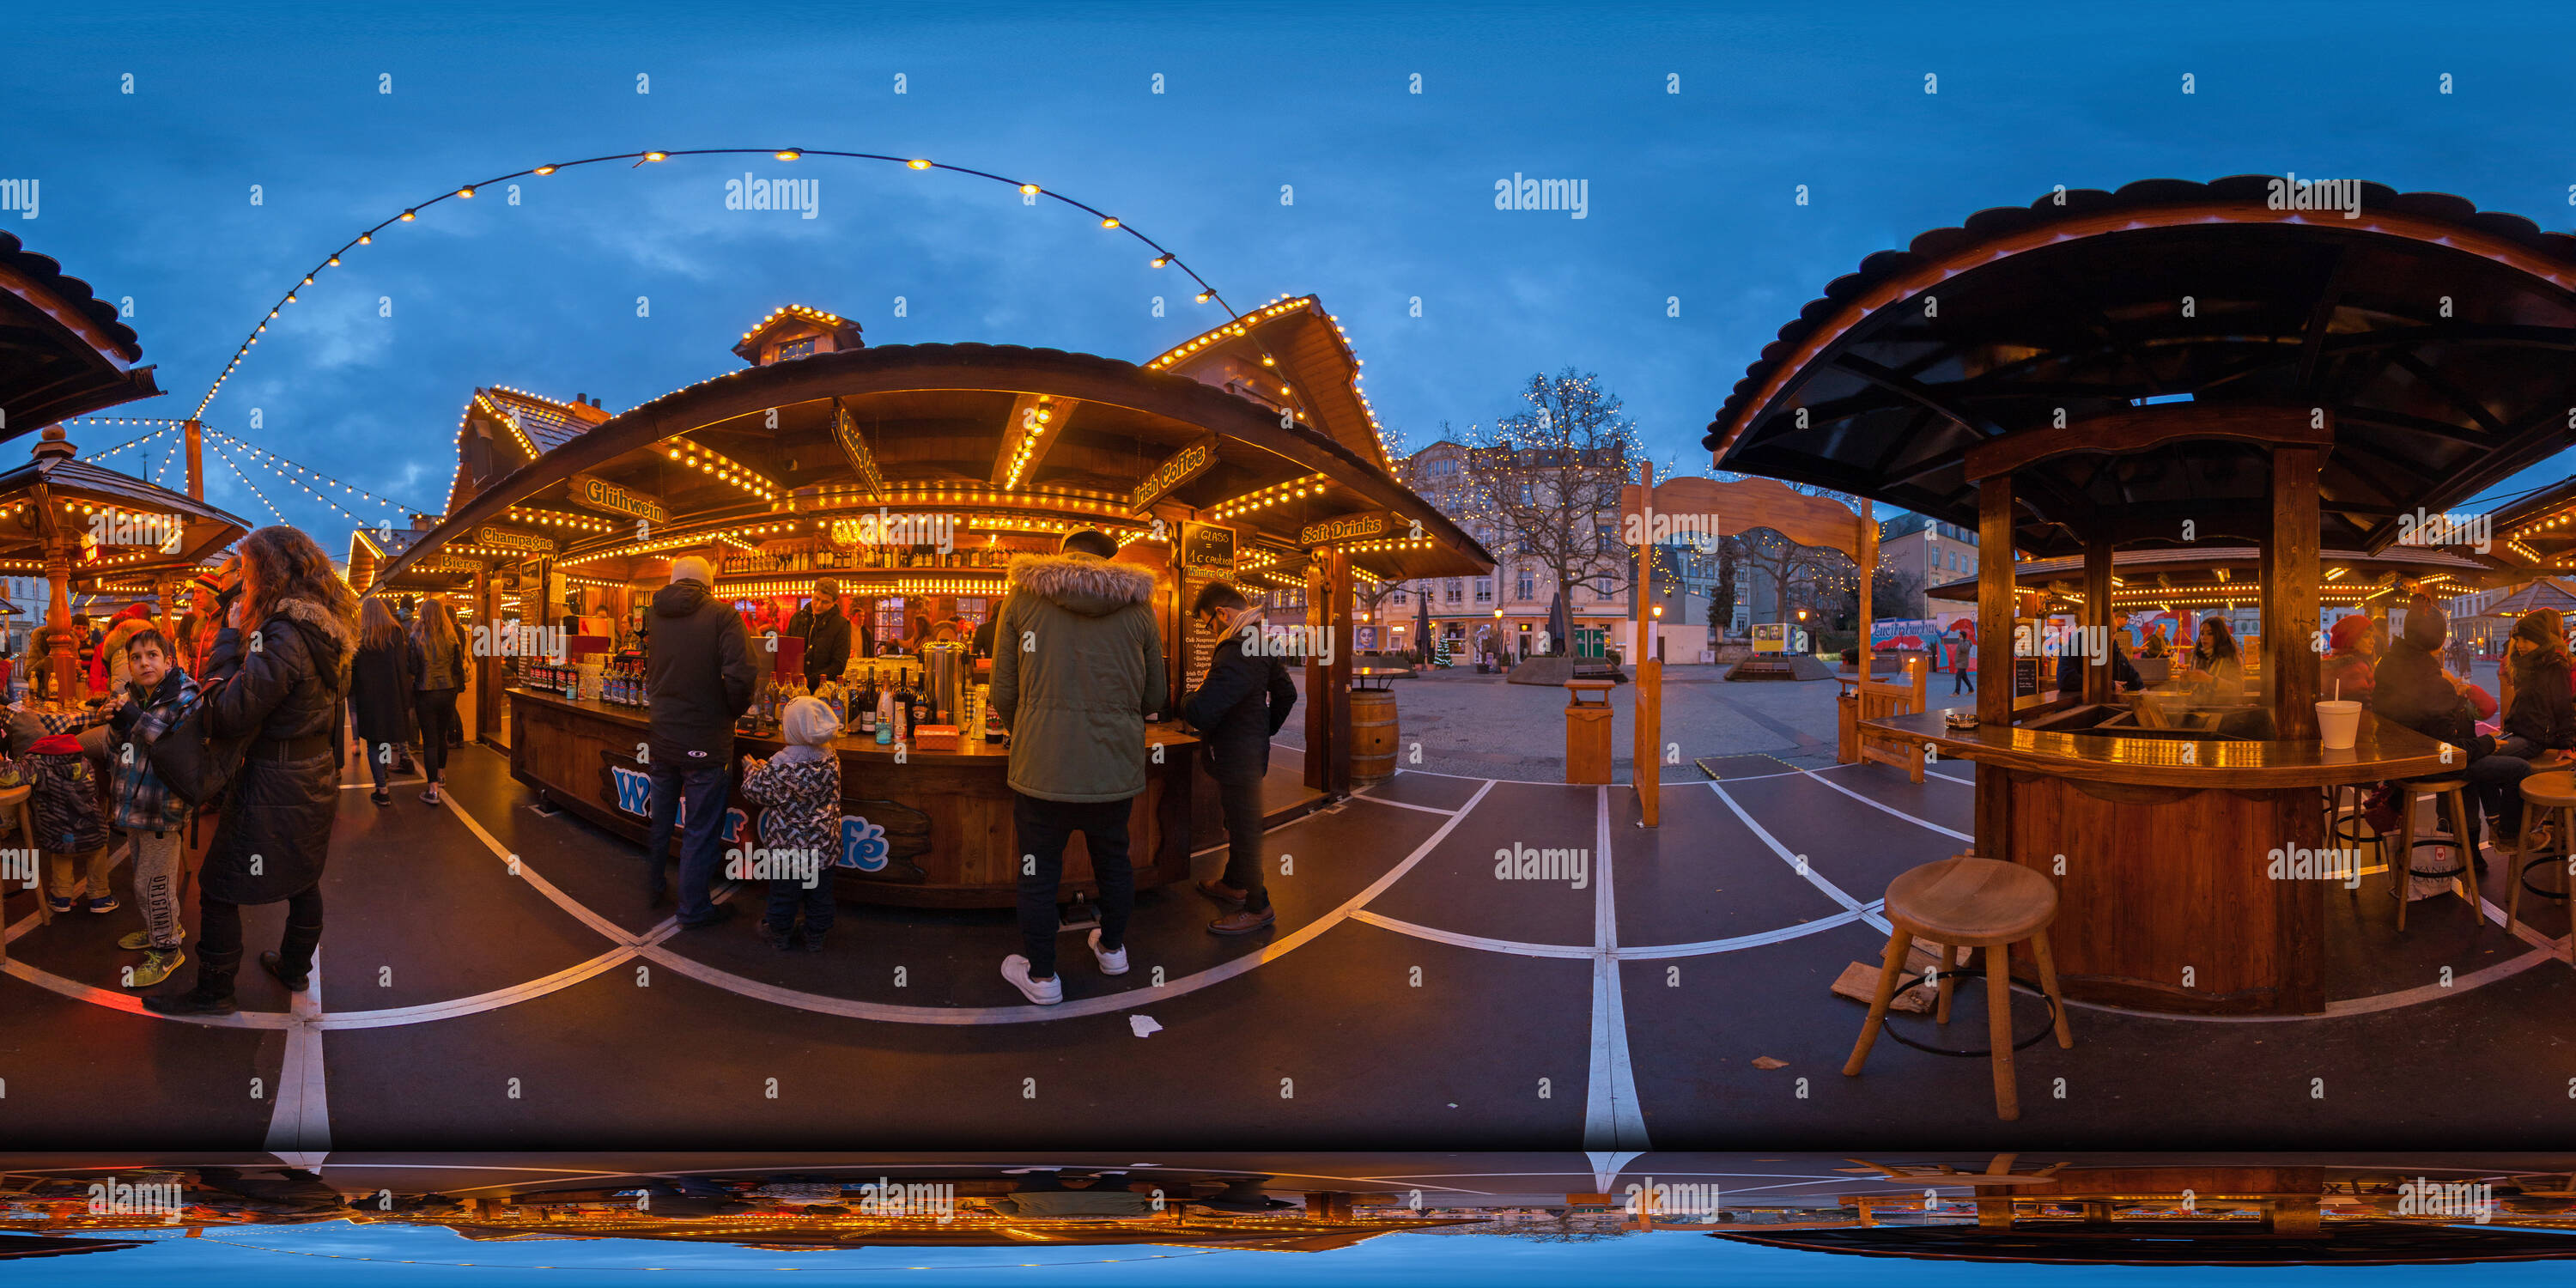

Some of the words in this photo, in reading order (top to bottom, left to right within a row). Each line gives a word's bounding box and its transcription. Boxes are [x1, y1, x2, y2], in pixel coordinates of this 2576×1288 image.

[1133, 474, 1158, 508] Irish
[1161, 446, 1206, 489] Coffee
[585, 479, 664, 523] Glühwein
[481, 527, 554, 551] Champagne
[1200, 530, 1229, 543] GLASS
[1302, 524, 1329, 544] Soft
[1331, 515, 1382, 539] Drinks
[440, 555, 483, 571] Bières
[1187, 565, 1216, 579] Winter
[150, 874, 170, 932] ORIGINAL
